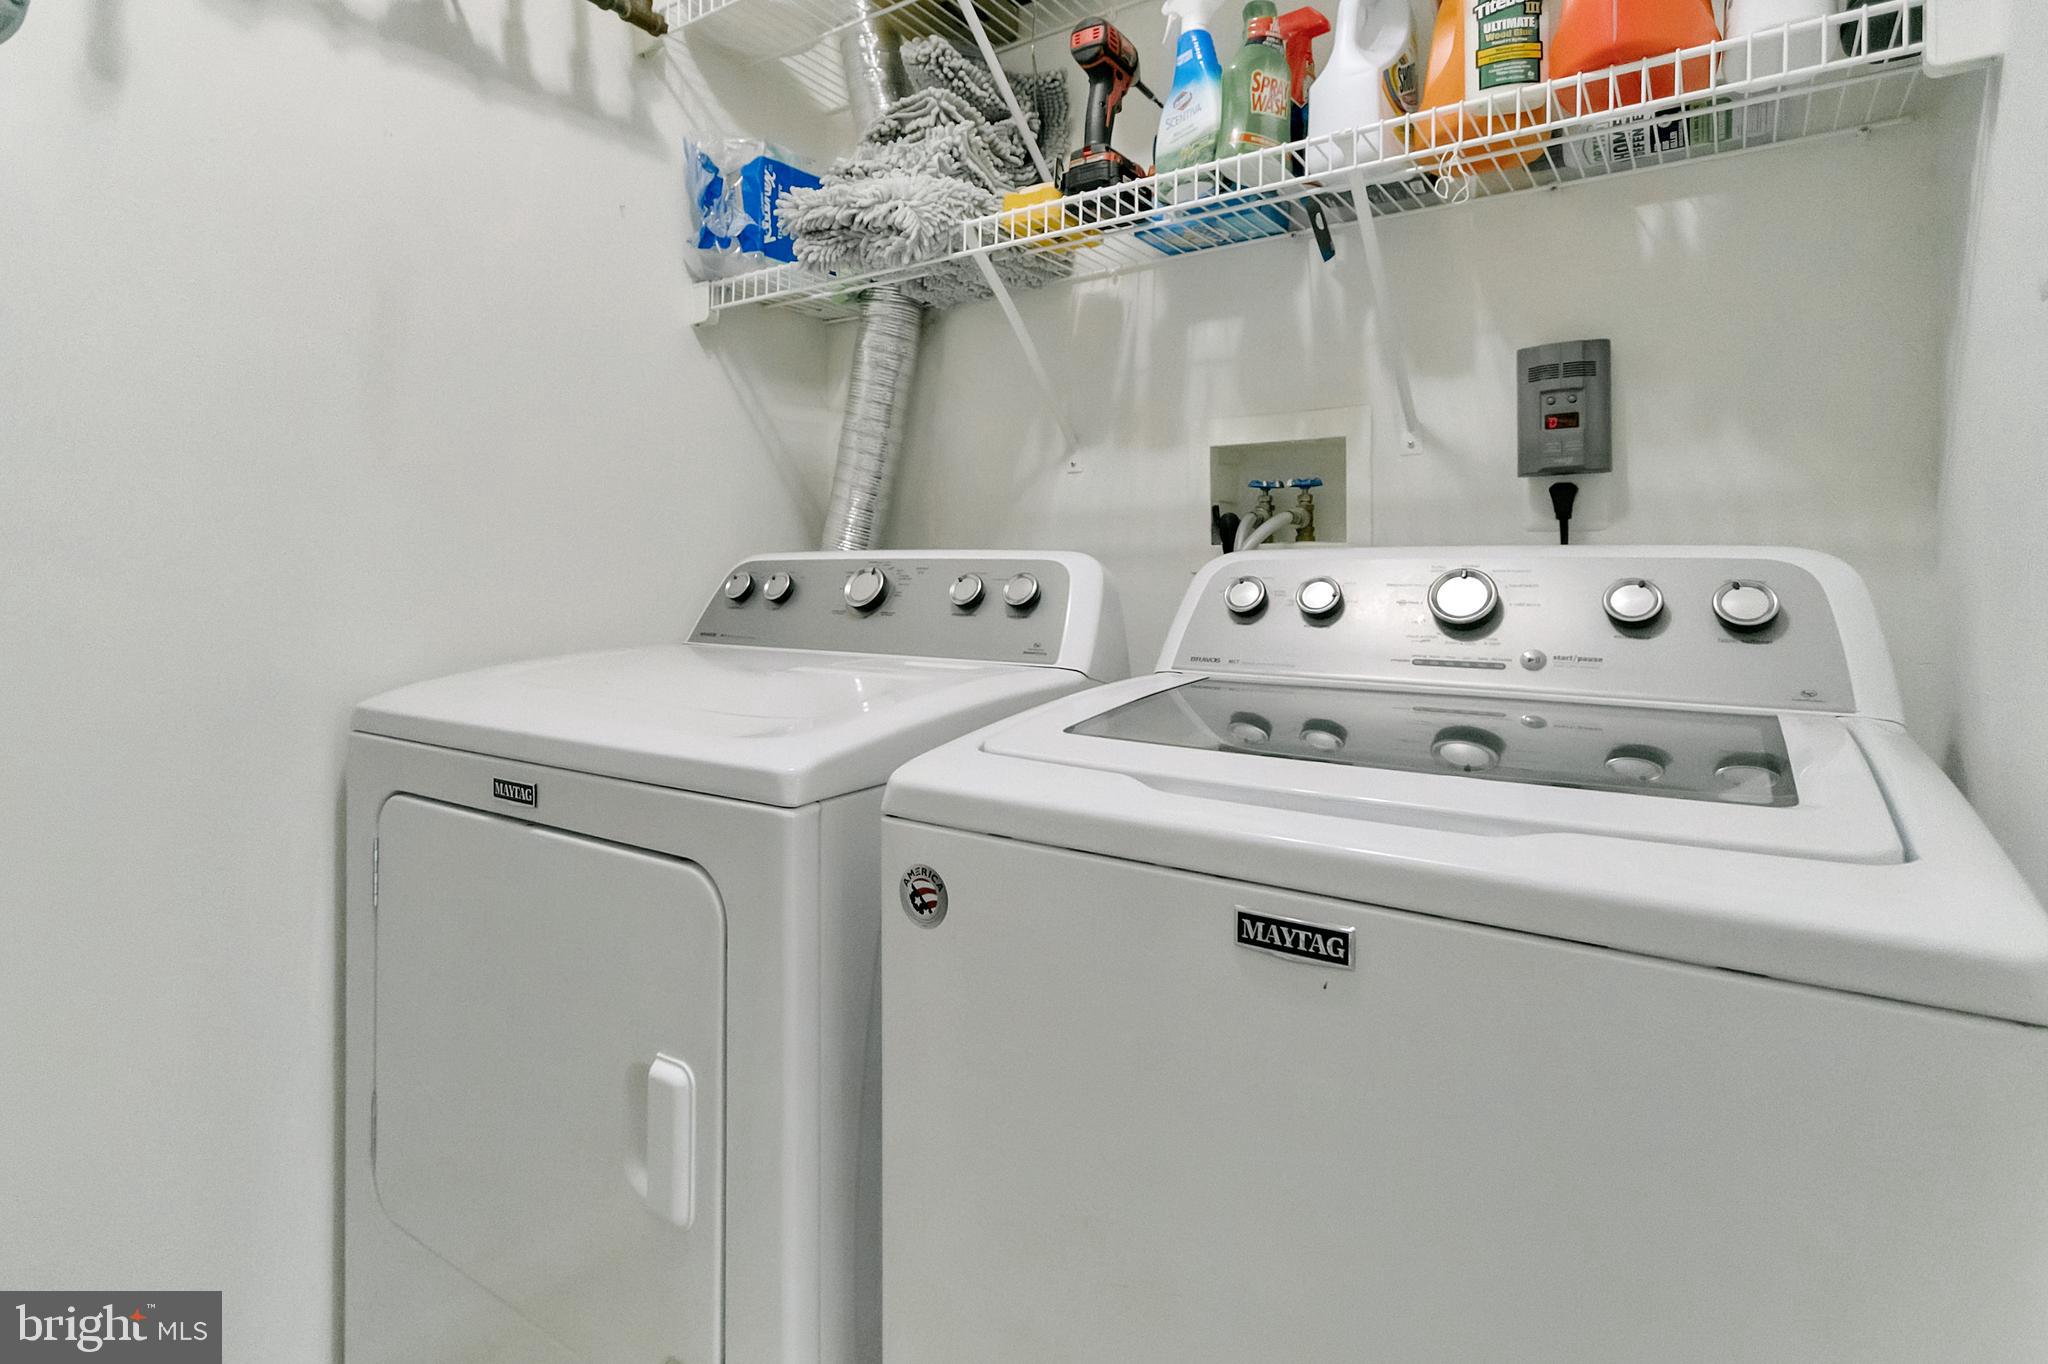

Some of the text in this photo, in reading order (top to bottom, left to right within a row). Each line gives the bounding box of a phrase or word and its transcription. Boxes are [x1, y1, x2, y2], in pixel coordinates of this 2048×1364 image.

[1484, 16, 1536, 33] ULTIMATE
[1485, 29, 1512, 41] Wood
[1252, 71, 1289, 97] SPRAY
[1251, 93, 1287, 114] WASH
[1632, 115, 1645, 156] DEFENE
[494, 781, 532, 801] MAYTAG
[903, 866, 944, 892] AMERICA
[1241, 918, 1346, 959] MAYTAG
